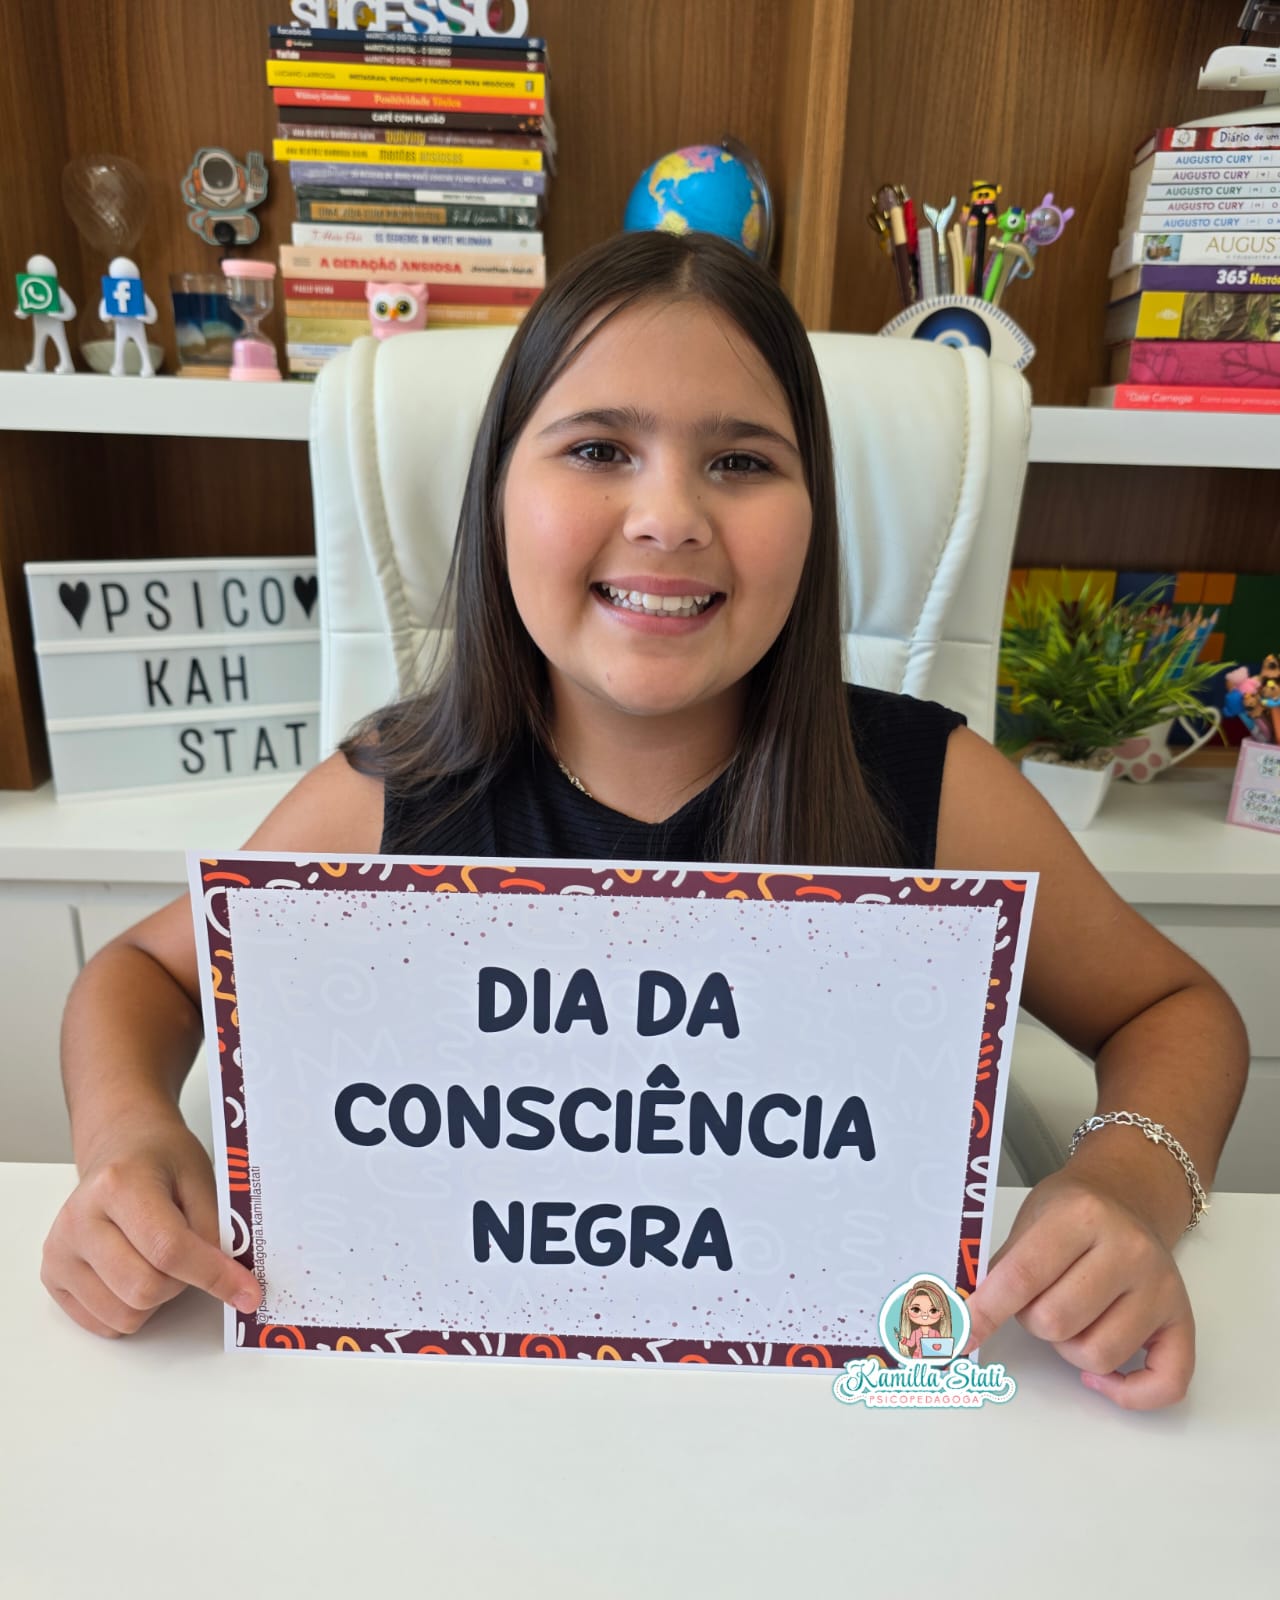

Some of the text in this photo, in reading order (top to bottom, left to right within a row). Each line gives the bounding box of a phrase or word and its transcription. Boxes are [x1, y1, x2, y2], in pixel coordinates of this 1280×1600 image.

[374, 94, 430, 106] Positividade
[371, 112, 446, 124] CAFÉ COM PLATÃO
[1220, 131, 1250, 143] Diário
[1254, 133, 1264, 141] de
[1175, 155, 1223, 165] AUGUSTO
[1226, 155, 1253, 164] CURY
[1172, 171, 1220, 180] AUGUSTO
[1223, 171, 1250, 179] CURY
[1166, 187, 1213, 196] AUGUSTO
[1216, 186, 1242, 195] CURY
[1168, 201, 1215, 211] AUGUSTO
[1218, 201, 1245, 210] CURY
[1163, 218, 1210, 227] AUGUSTO
[1213, 218, 1240, 226] CURY
[1205, 236, 1280, 253] AUGUS
[320, 257, 329, 268] A
[333, 256, 396, 272] GERAÇÃO
[400, 260, 462, 273] ANSIOSA
[1216, 269, 1248, 285] 365
[1152, 393, 1193, 405] Carnegie
[101, 577, 286, 632] PSICO
[145, 655, 249, 707] KAH
[180, 722, 307, 775] STAT
[478, 966, 740, 1039] DIA DA
[334, 1063, 876, 1161] CONSCIÊNCIA
[472, 1200, 733, 1271] NEGRA
